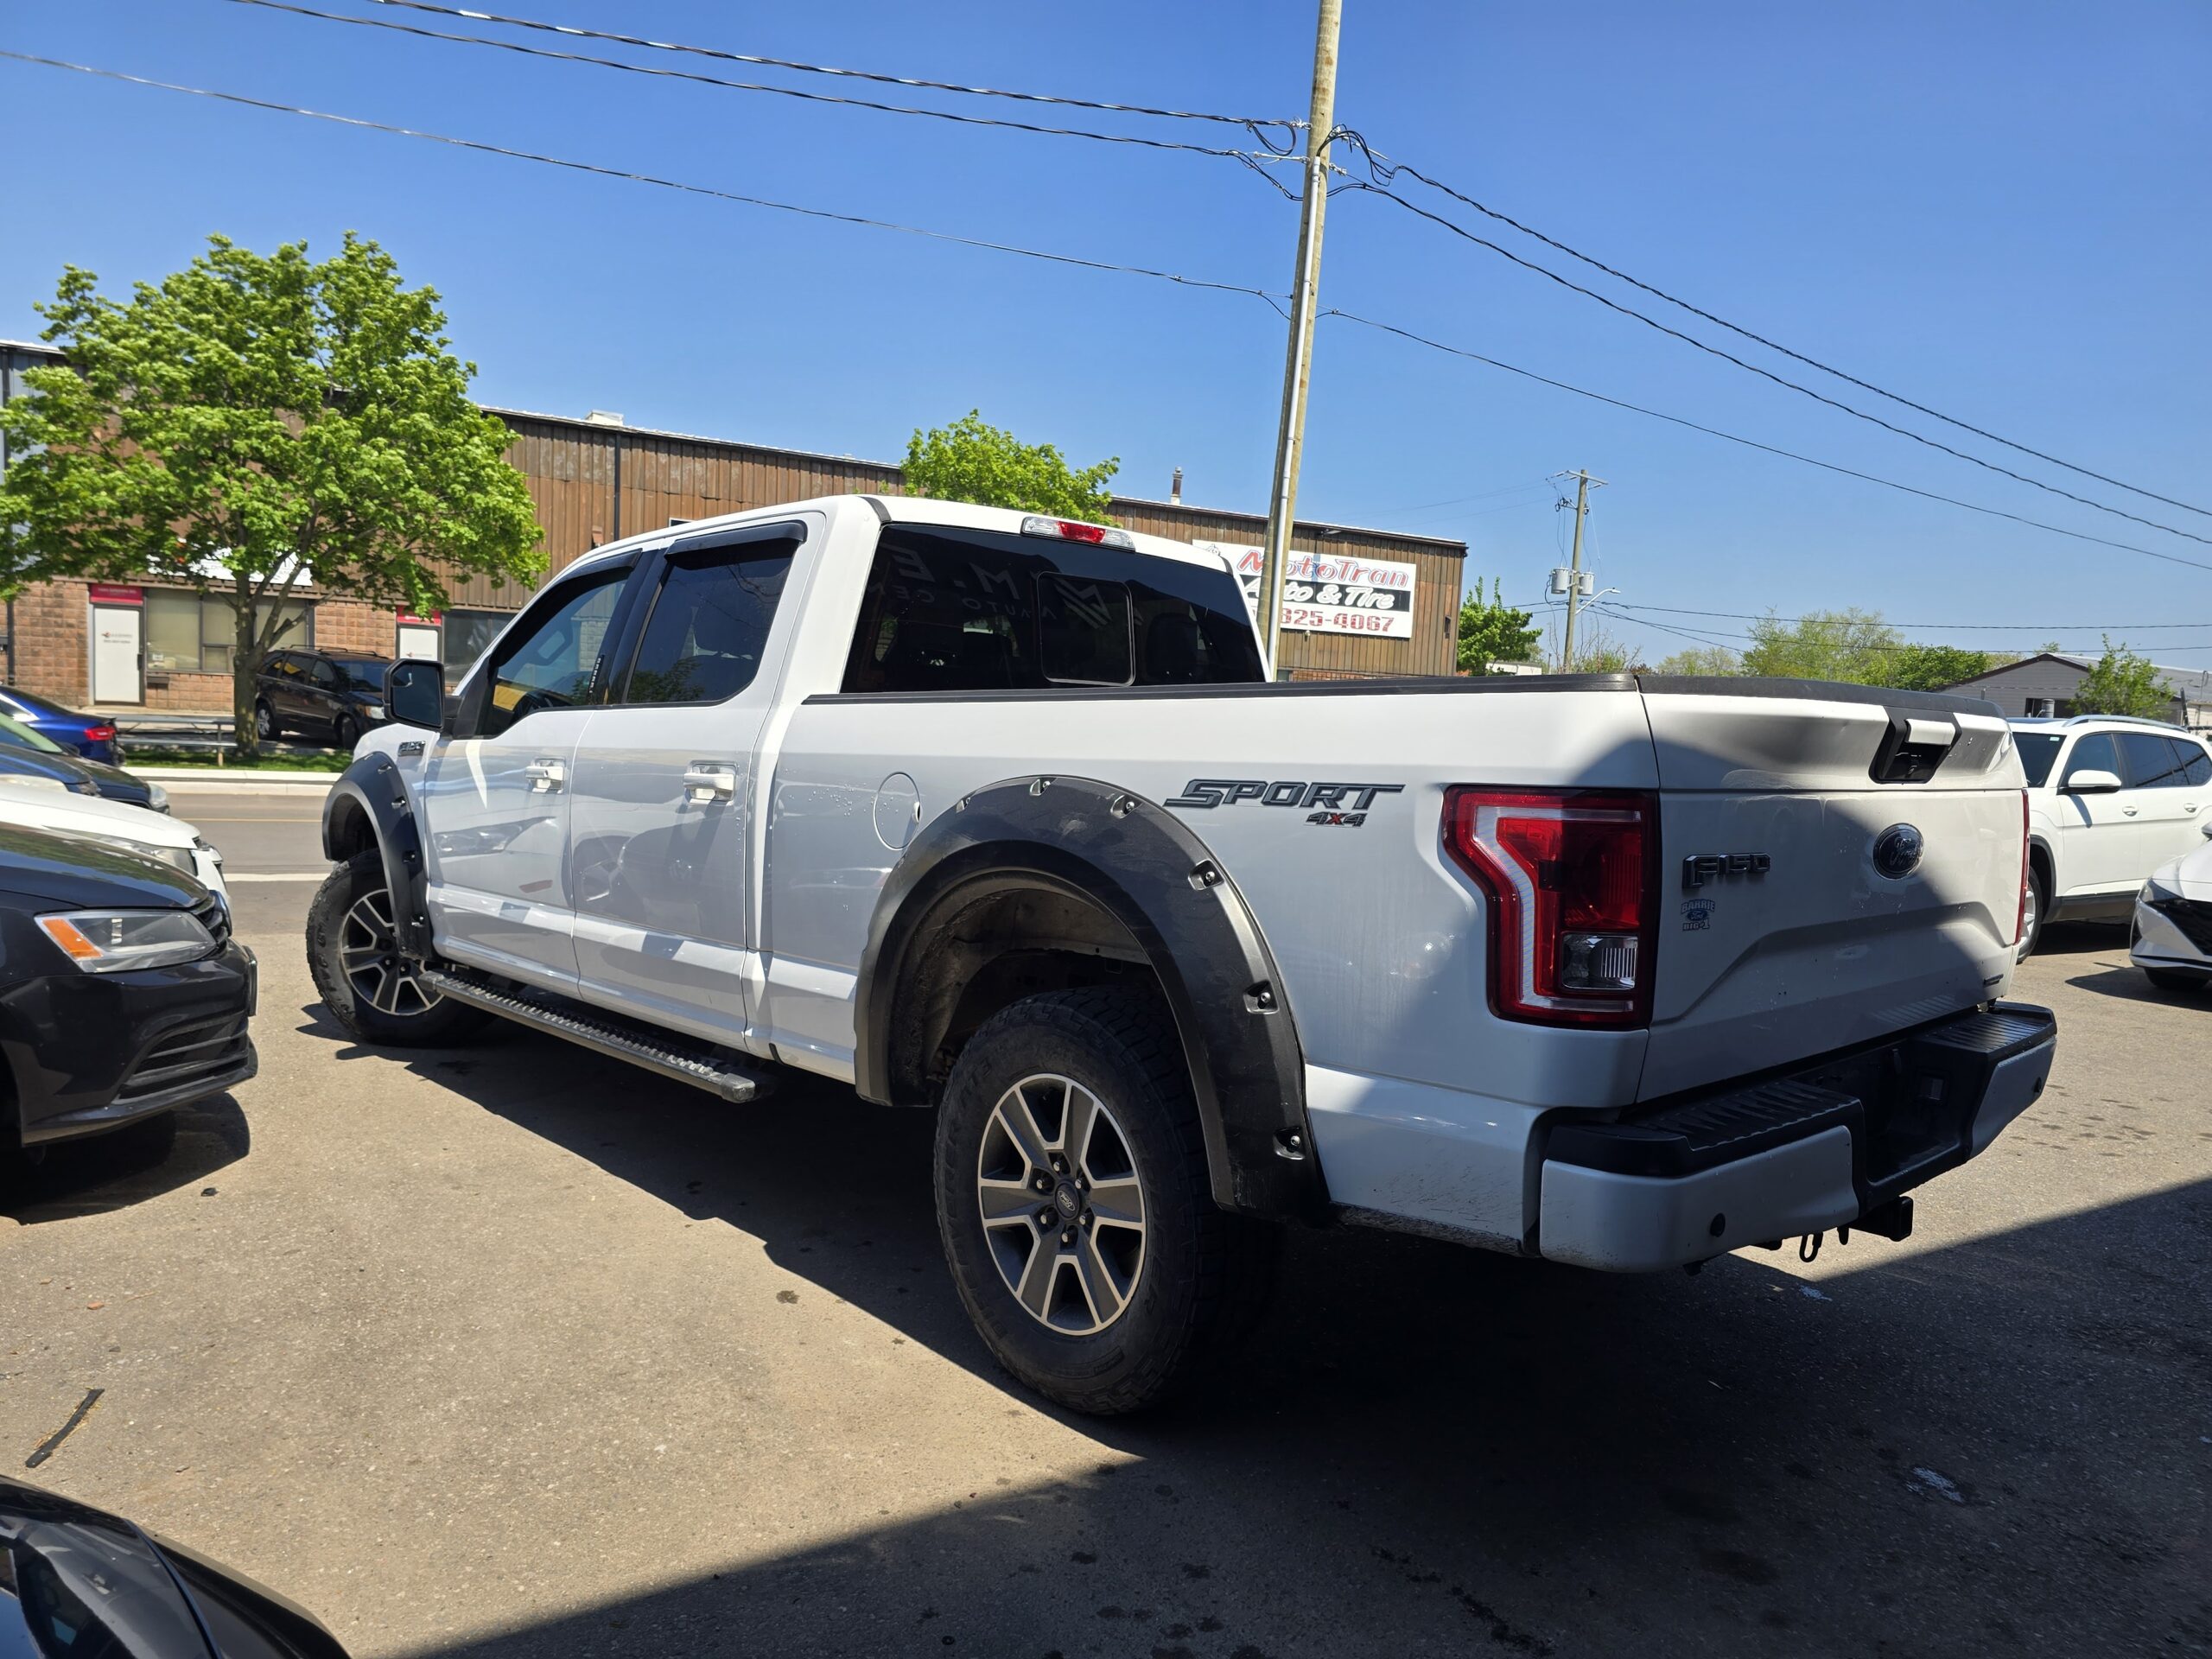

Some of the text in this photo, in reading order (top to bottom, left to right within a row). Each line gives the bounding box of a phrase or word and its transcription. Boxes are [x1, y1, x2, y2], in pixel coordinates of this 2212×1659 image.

[1316, 584, 1342, 605] &
[1344, 587, 1395, 609] Tire
[1163, 779, 1406, 809] SPORT
[1681, 899, 1715, 914] BARRIE
